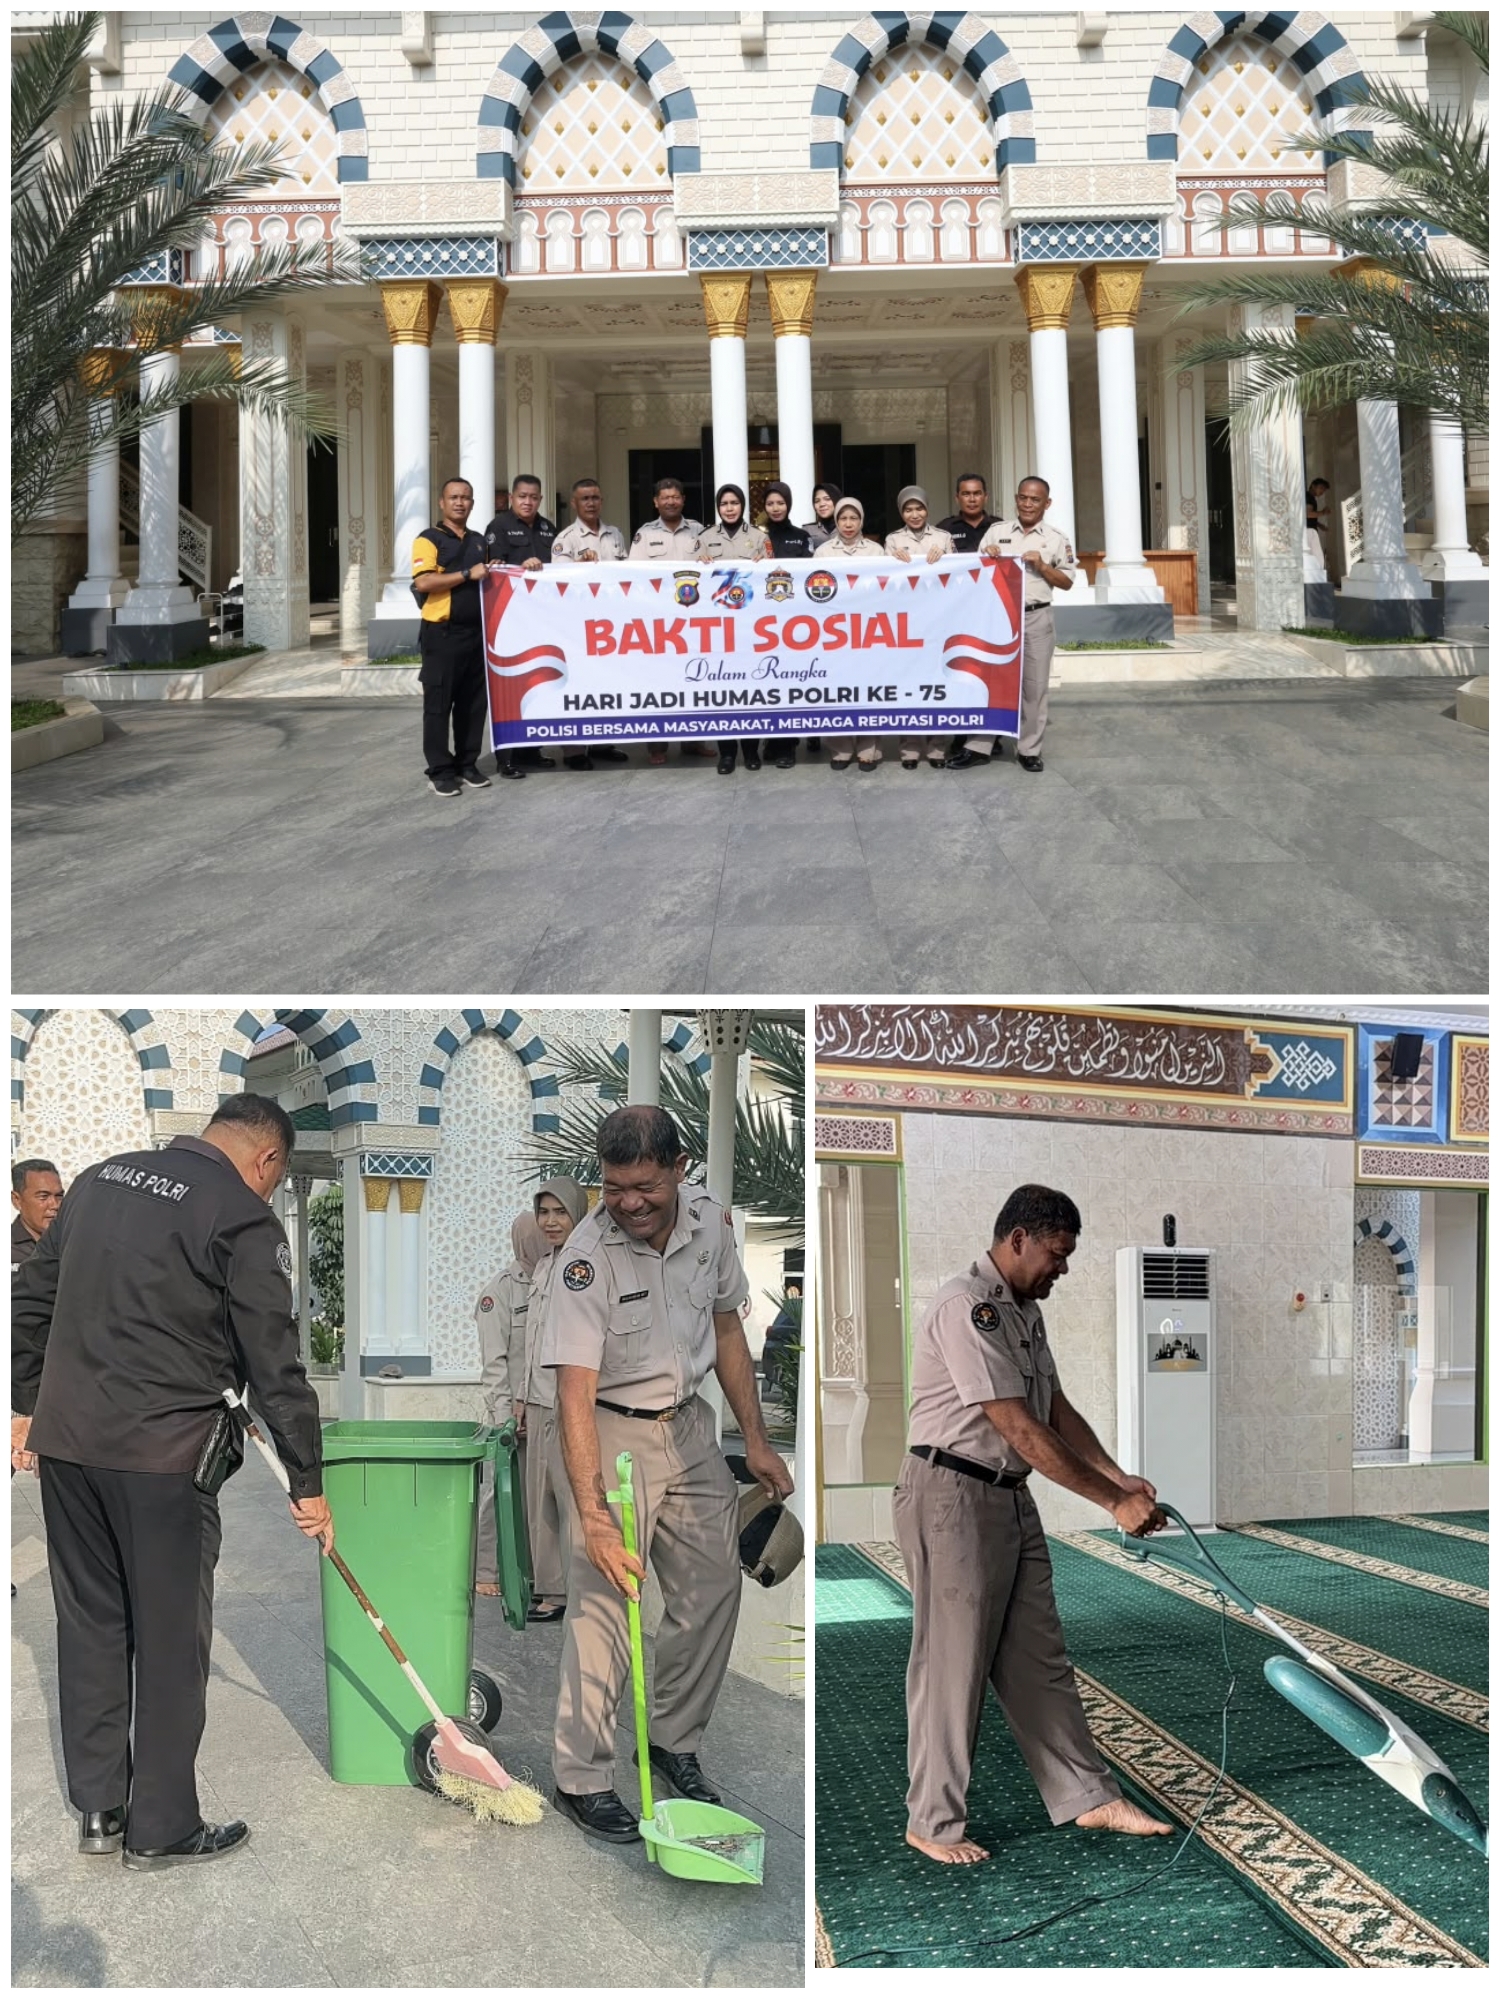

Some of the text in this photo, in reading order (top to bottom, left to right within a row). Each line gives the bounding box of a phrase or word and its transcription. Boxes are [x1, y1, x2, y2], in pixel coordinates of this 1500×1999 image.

[584, 612, 924, 656] BAKTI SOSIAL
[685, 655, 828, 682] Dalam Rangka
[563, 692, 622, 711] HARI
[630, 691, 685, 710] JADI
[693, 688, 781, 708] HUMAS
[788, 686, 859, 705] POLRI
[867, 685, 897, 702] KE
[919, 684, 947, 701] 75
[526, 714, 984, 738] POLISI BERSAMA MASYARAKAT, MENJAGA REPUTASI POLRI
[97, 1164, 190, 1201] HUMAS POLRI
